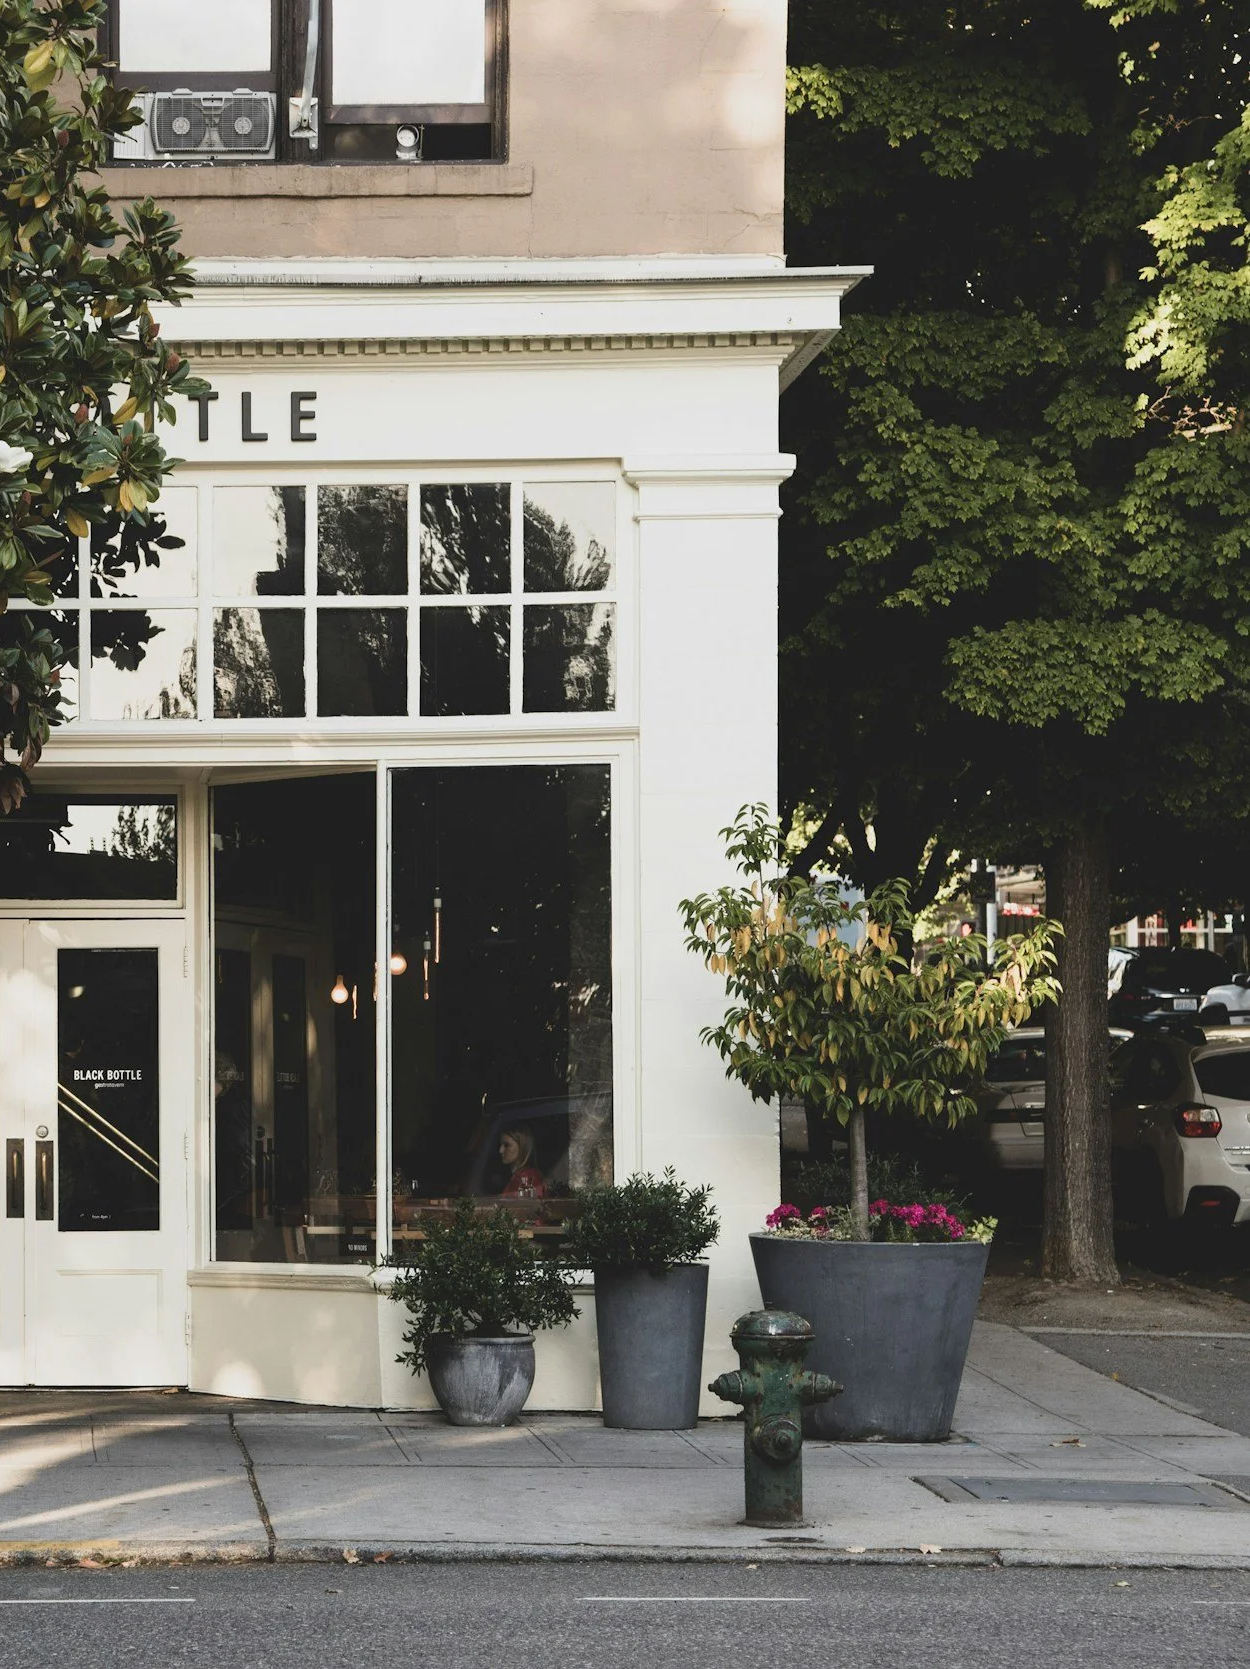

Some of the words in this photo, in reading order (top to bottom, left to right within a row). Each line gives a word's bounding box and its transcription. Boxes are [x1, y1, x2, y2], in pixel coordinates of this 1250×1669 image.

[73, 1069, 104, 1081] BLACK
[106, 1069, 142, 1081] BOTTLE
[94, 1082, 125, 1090] gastrotavern
